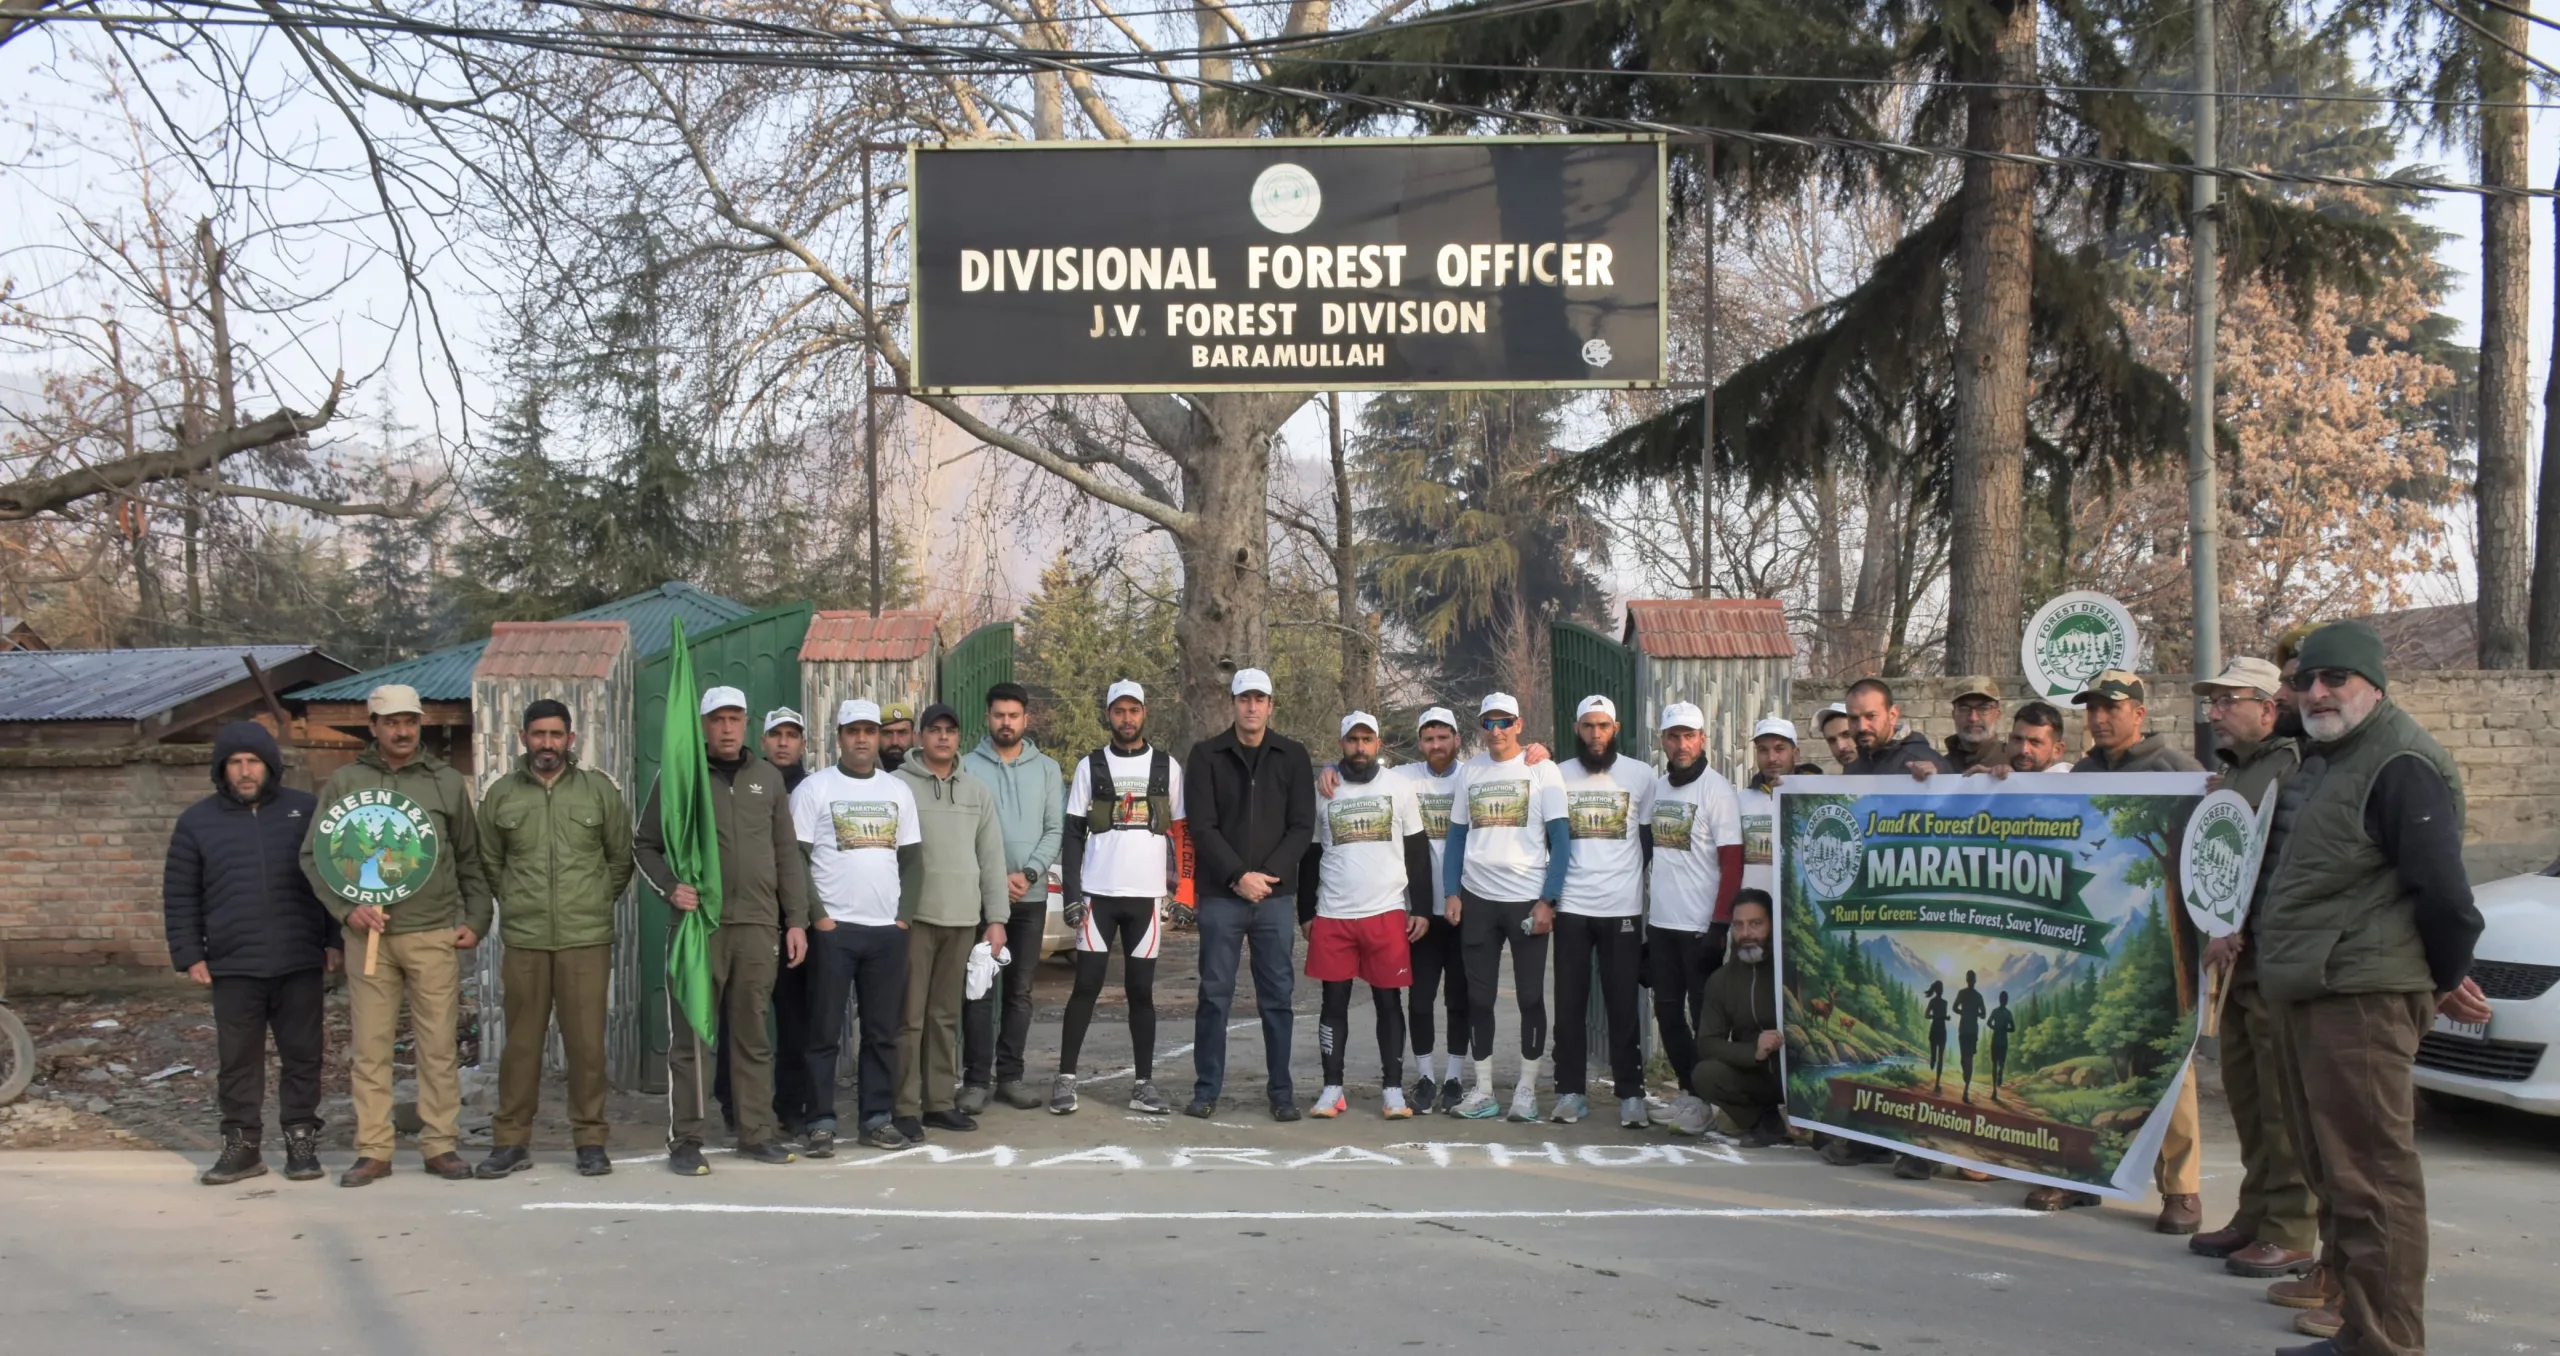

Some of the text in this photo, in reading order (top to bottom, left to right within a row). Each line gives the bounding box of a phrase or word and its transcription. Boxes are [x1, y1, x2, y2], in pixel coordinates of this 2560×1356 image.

[960, 242, 1615, 292] DIVISIONAL FOREST OFFICER
[1167, 302, 1297, 337] FOREST
[1322, 300, 1486, 335] DIVISION
[1191, 342, 1385, 368] BARAMULLAH
[2040, 604, 2077, 639] FOREST
[2081, 604, 2122, 668] DEPARTMENT
[2037, 647, 2046, 655] K
[319, 790, 434, 840] GREEN J&K
[1865, 813, 2081, 841] J and K Forest Department
[2200, 806, 2231, 833] FOREST
[1806, 806, 1832, 836] FOREST
[1835, 807, 1862, 879] DEPARTMENT
[1182, 850, 1194, 878] CLUB
[1867, 845, 2063, 901] MARATHON
[342, 884, 412, 903] DRIVE
[1860, 905, 1876, 925] for
[1878, 905, 1917, 921] Green:
[1919, 905, 1947, 922] Save
[1949, 908, 1966, 924] the
[1968, 908, 2004, 930] Forest,
[2006, 913, 2032, 933] Save
[2034, 918, 2087, 946] Yourself.
[1319, 1023, 1333, 1056] NIKE
[1853, 1089, 2060, 1152] JV Forest Division Baramulla
[836, 1141, 1750, 1169] MARATHON
